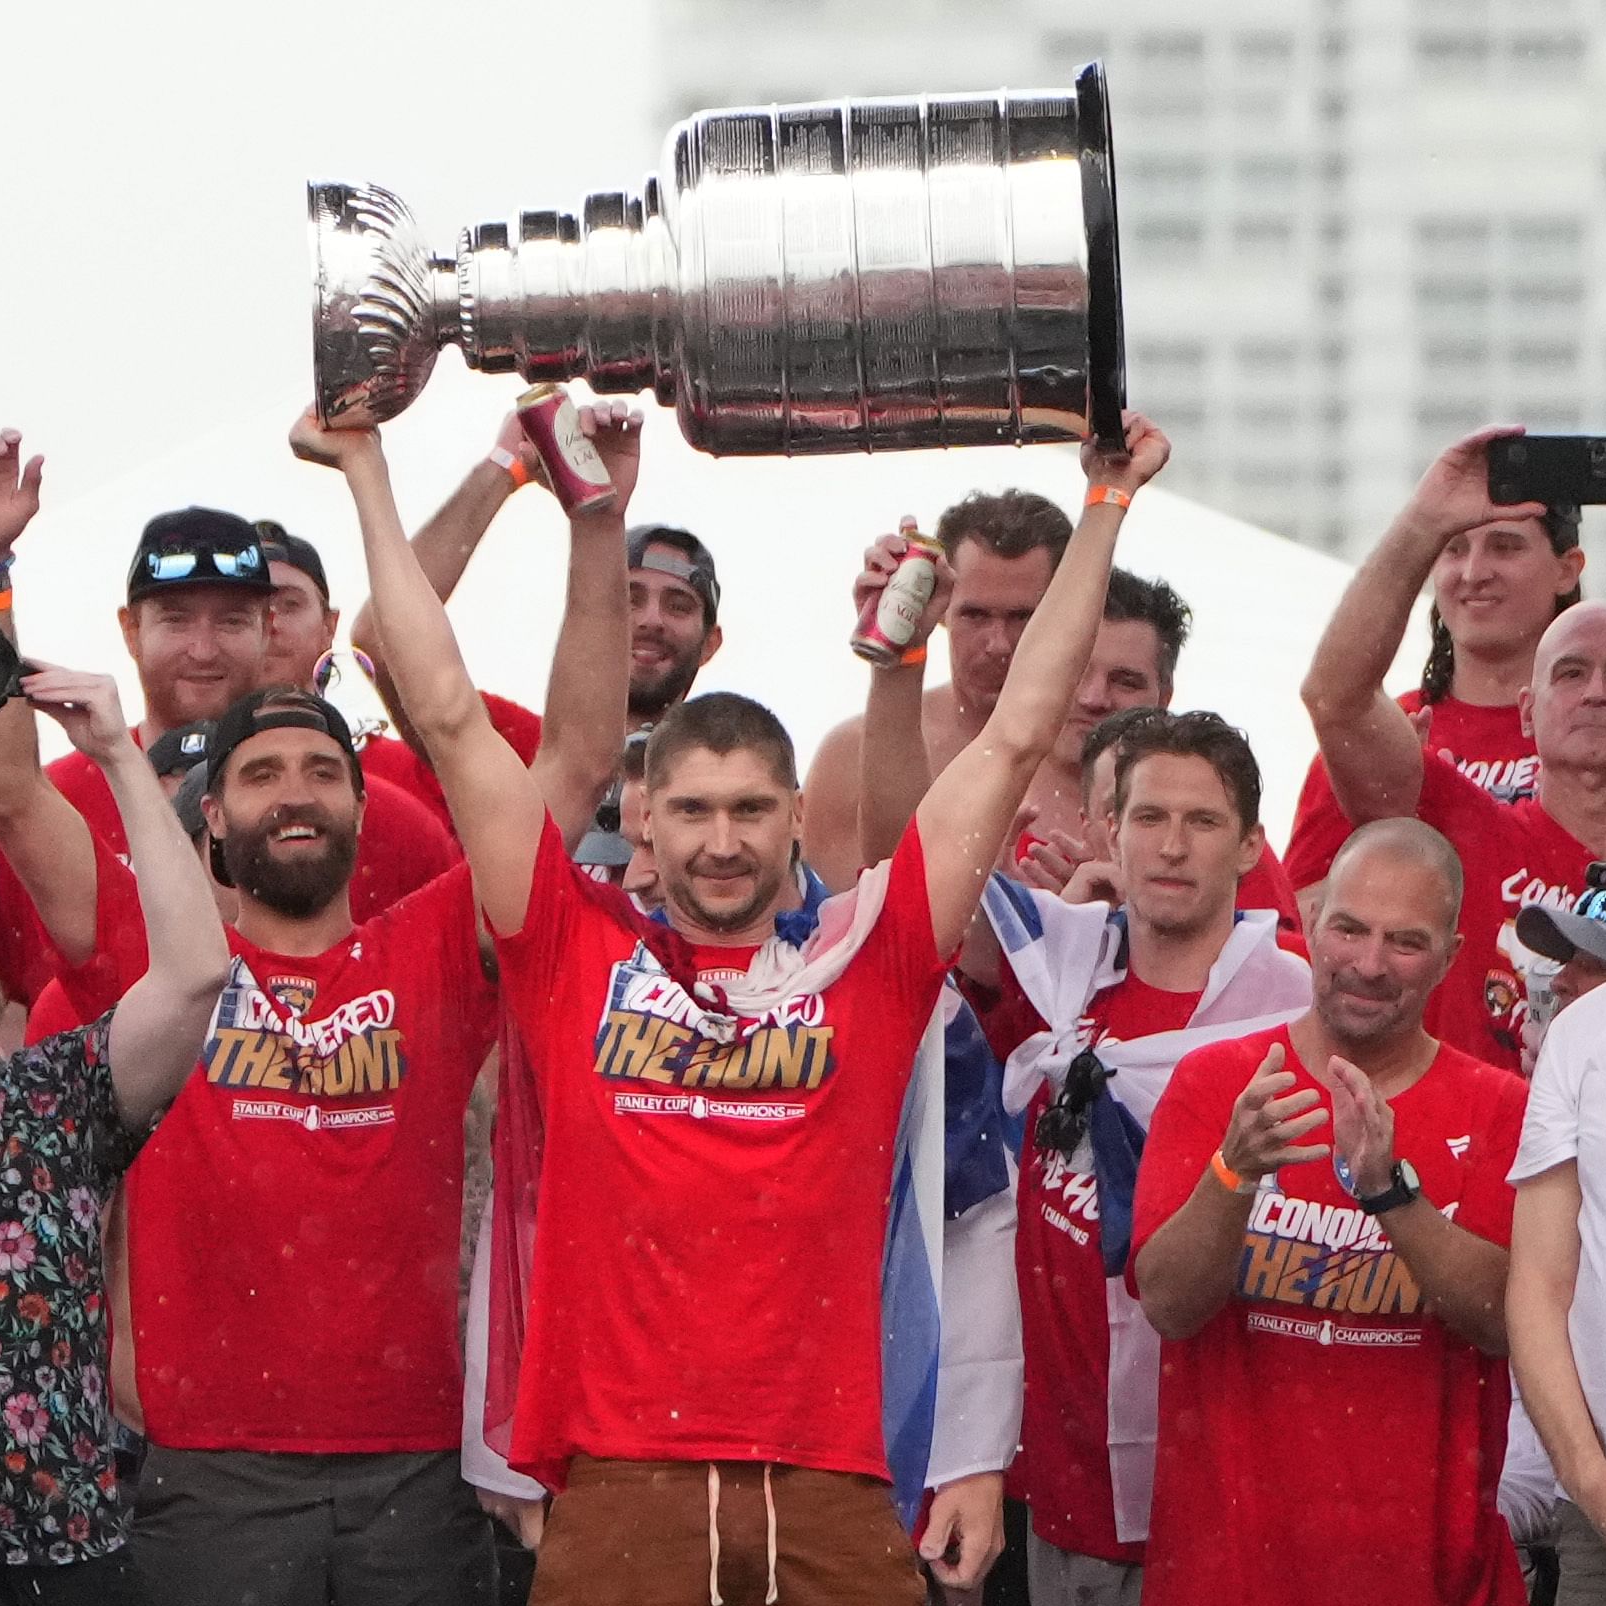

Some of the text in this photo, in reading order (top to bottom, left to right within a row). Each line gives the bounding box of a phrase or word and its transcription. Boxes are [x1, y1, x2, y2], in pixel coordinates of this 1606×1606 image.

[206, 1028, 294, 1090] THE
[593, 1010, 835, 1089] THE HUNT
[232, 1102, 280, 1117] STANLEY
[282, 1106, 304, 1119] CUP
[614, 1096, 663, 1111] STANLEY
[664, 1099, 689, 1111] CUP
[709, 1105, 786, 1118] CHAMPIONS
[1248, 1315, 1293, 1332] STANLEY
[1295, 1324, 1316, 1337] CUP
[1335, 1329, 1403, 1344] CHAMPIONS
